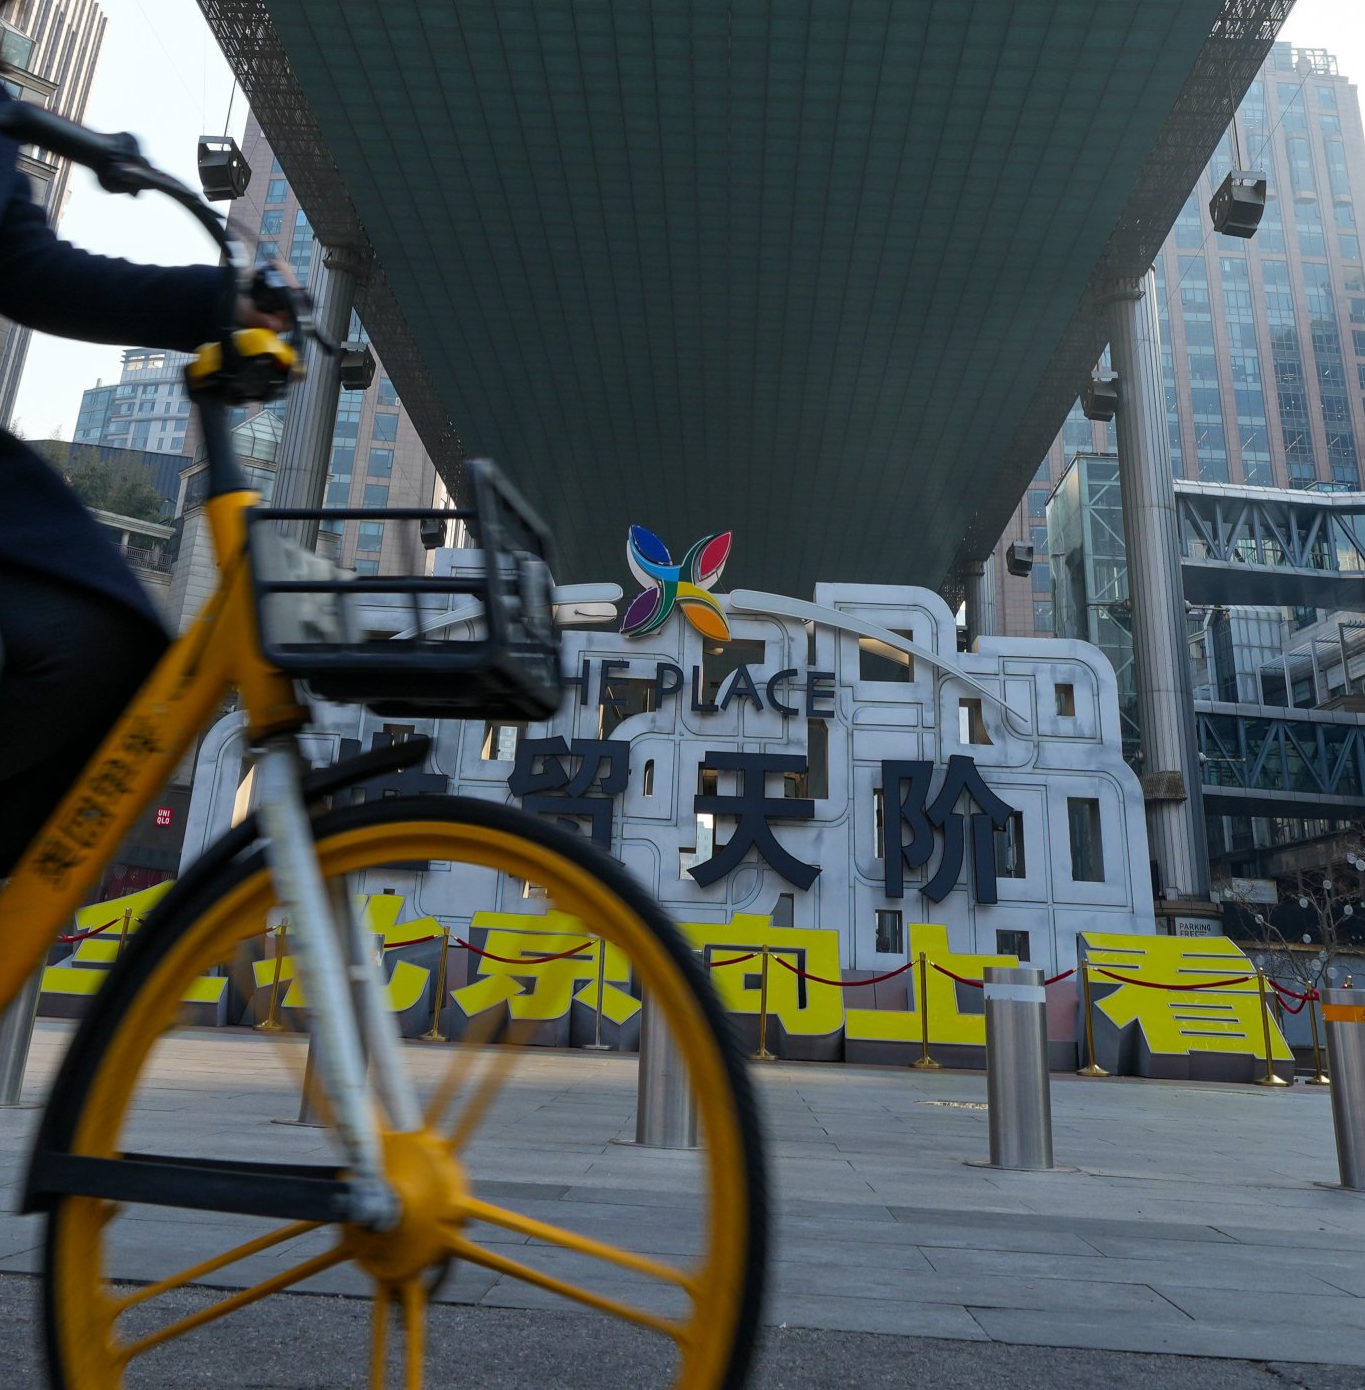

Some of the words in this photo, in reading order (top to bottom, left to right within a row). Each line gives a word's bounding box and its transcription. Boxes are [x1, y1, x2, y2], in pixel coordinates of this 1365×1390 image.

[554, 657, 631, 706] HE
[655, 662, 836, 718] PLACE
[157, 809, 170, 817] UNI
[156, 817, 170, 825] QLO
[1179, 922, 1211, 931] PARKING
